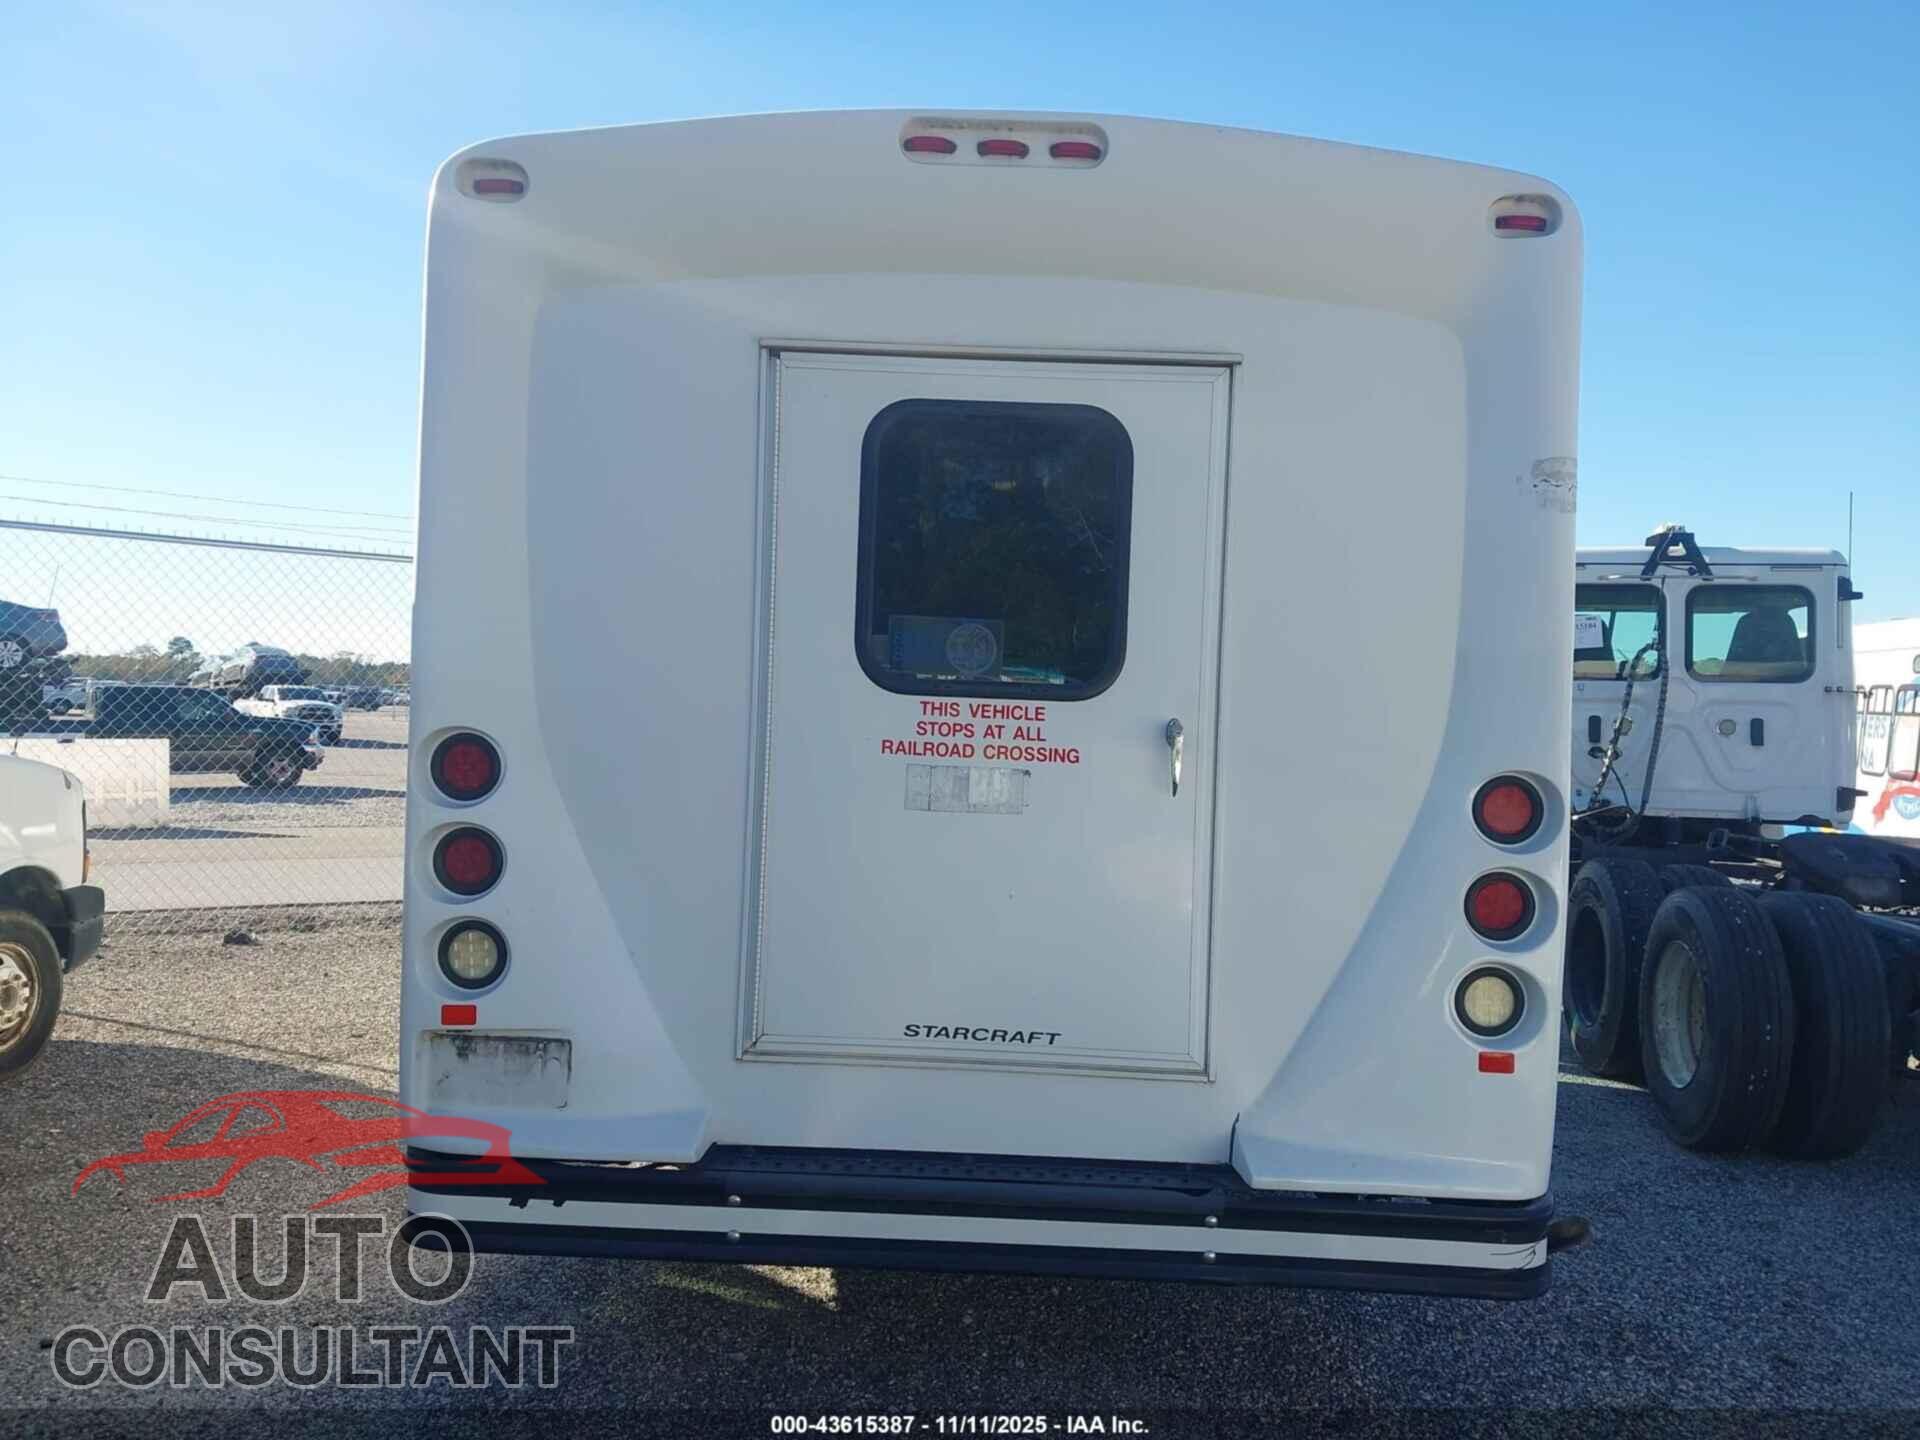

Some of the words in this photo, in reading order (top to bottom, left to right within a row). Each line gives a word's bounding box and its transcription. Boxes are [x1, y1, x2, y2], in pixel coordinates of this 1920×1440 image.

[920, 700, 960, 717] THIS
[969, 703, 1046, 721] VEHICLE
[916, 720, 975, 738] STOPS
[983, 725, 1005, 739] AT
[1013, 727, 1046, 742] ALL
[881, 740, 975, 759] RAILROAD
[983, 745, 1080, 764] CROSSING
[903, 1024, 1062, 1045] STARCRAFT
